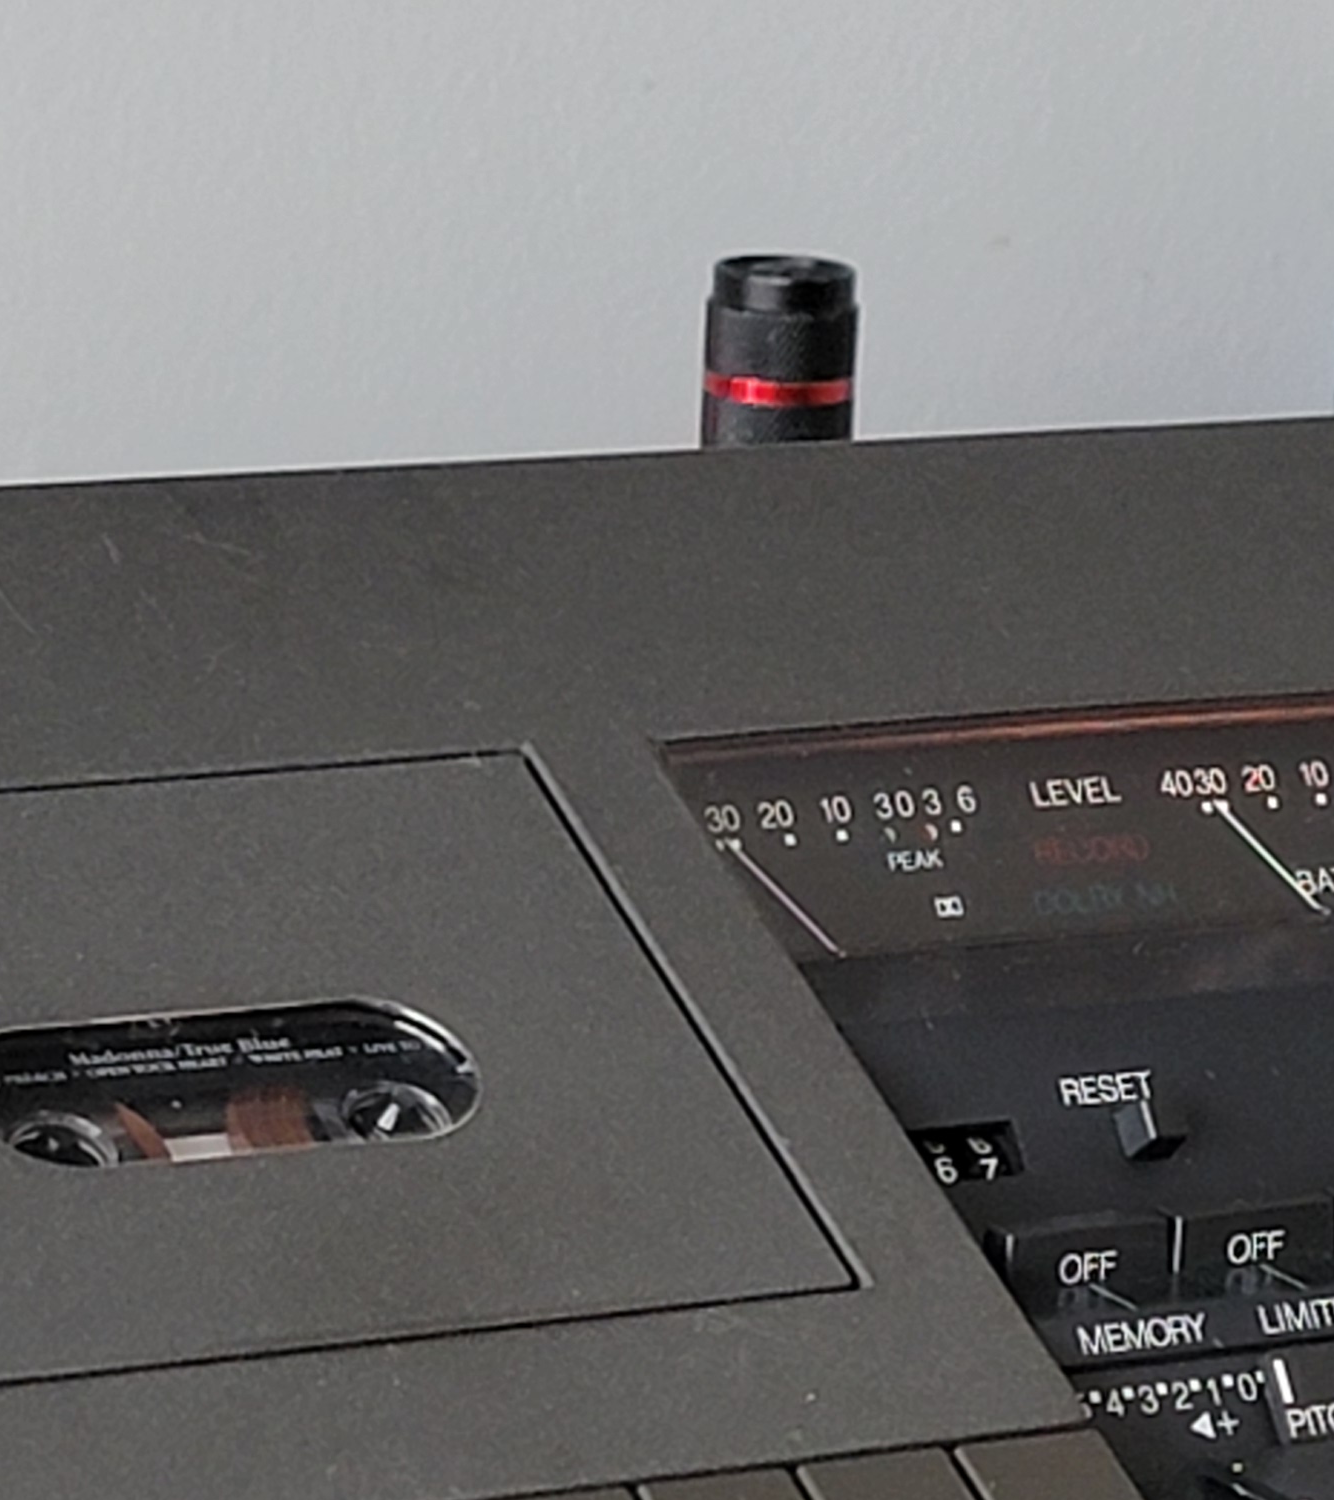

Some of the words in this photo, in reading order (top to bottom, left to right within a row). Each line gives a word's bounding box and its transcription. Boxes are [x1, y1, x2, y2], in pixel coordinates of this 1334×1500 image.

[1241, 764, 1276, 793] 20
[1299, 760, 1329, 788] 10
[757, 799, 794, 829] 20
[820, 795, 852, 823] 10
[1029, 776, 1122, 807] LEVEL
[887, 849, 944, 871] PEAK
[237, 1036, 296, 1057] Blue
[1059, 1070, 1151, 1108] RESET
[1059, 1249, 1118, 1285] OFF
[1227, 1229, 1285, 1265] OFF
[1076, 1312, 1205, 1355] MEMORY
